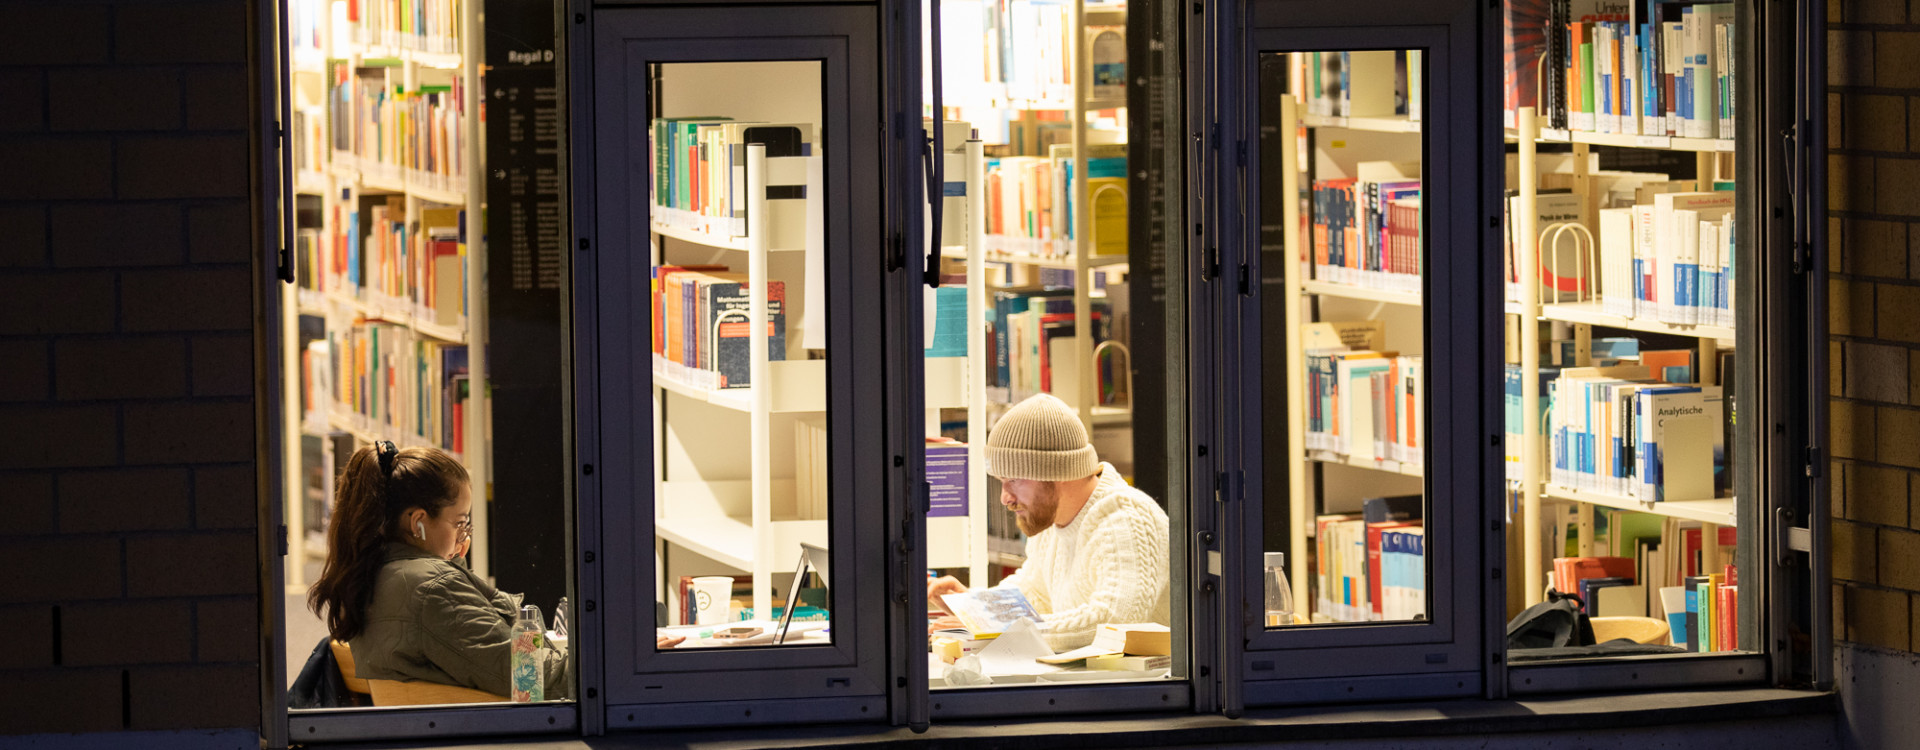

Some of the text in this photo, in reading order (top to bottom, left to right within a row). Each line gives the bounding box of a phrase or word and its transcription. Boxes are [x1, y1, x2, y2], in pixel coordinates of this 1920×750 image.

[508, 50, 554, 66] Regal D
[1658, 405, 1703, 418] Analytische
[1658, 419, 1664, 428] C
